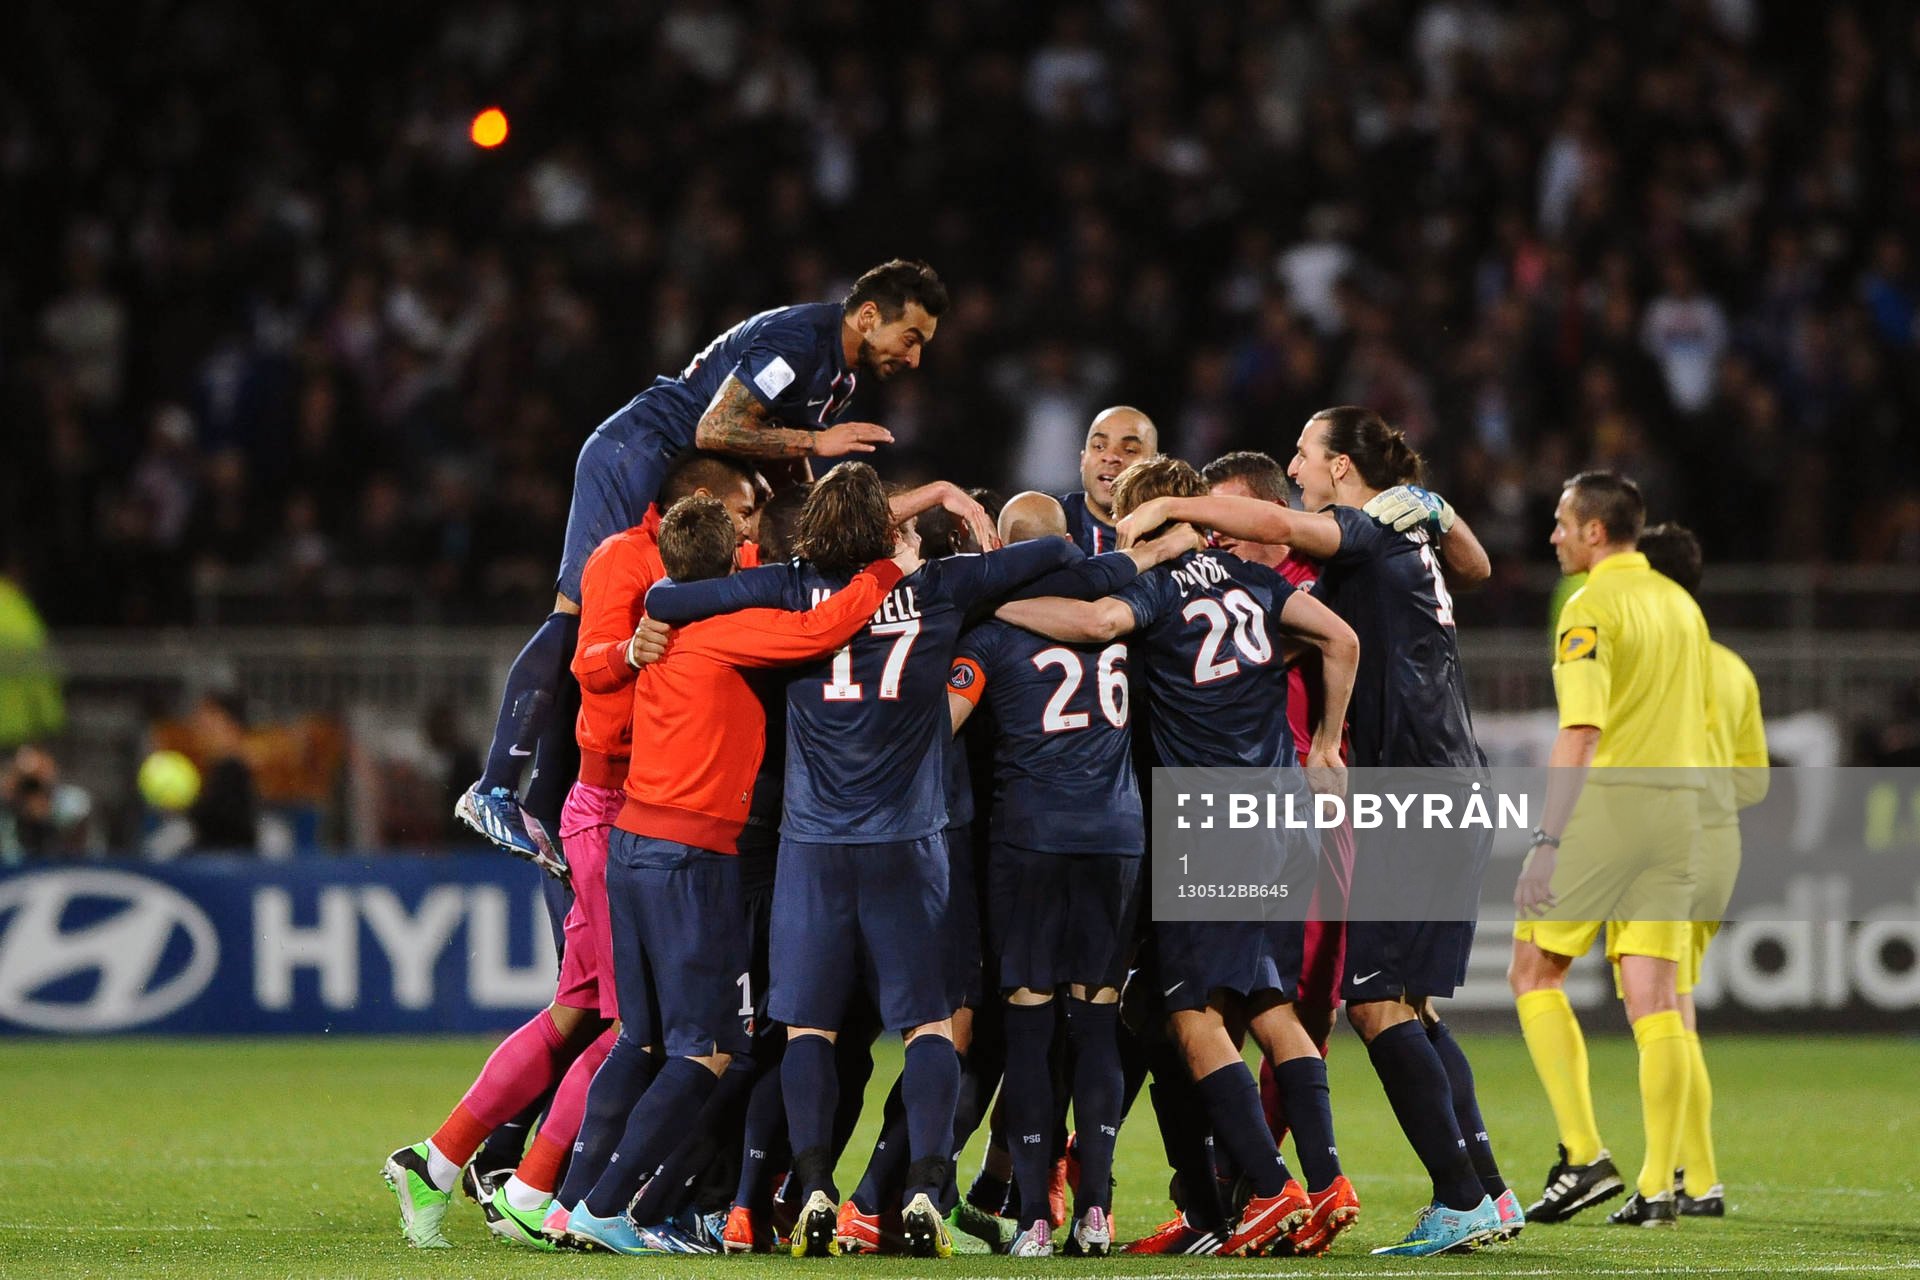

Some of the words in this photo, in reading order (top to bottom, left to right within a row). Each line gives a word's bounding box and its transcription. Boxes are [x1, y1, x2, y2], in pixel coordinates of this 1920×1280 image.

[822, 618, 922, 701] 17
[1183, 588, 1273, 684] 20
[1031, 642, 1130, 734] 26
[736, 972, 754, 1016] 1
[1023, 1134, 1041, 1144] PSG
[1101, 1125, 1116, 1137] PSG
